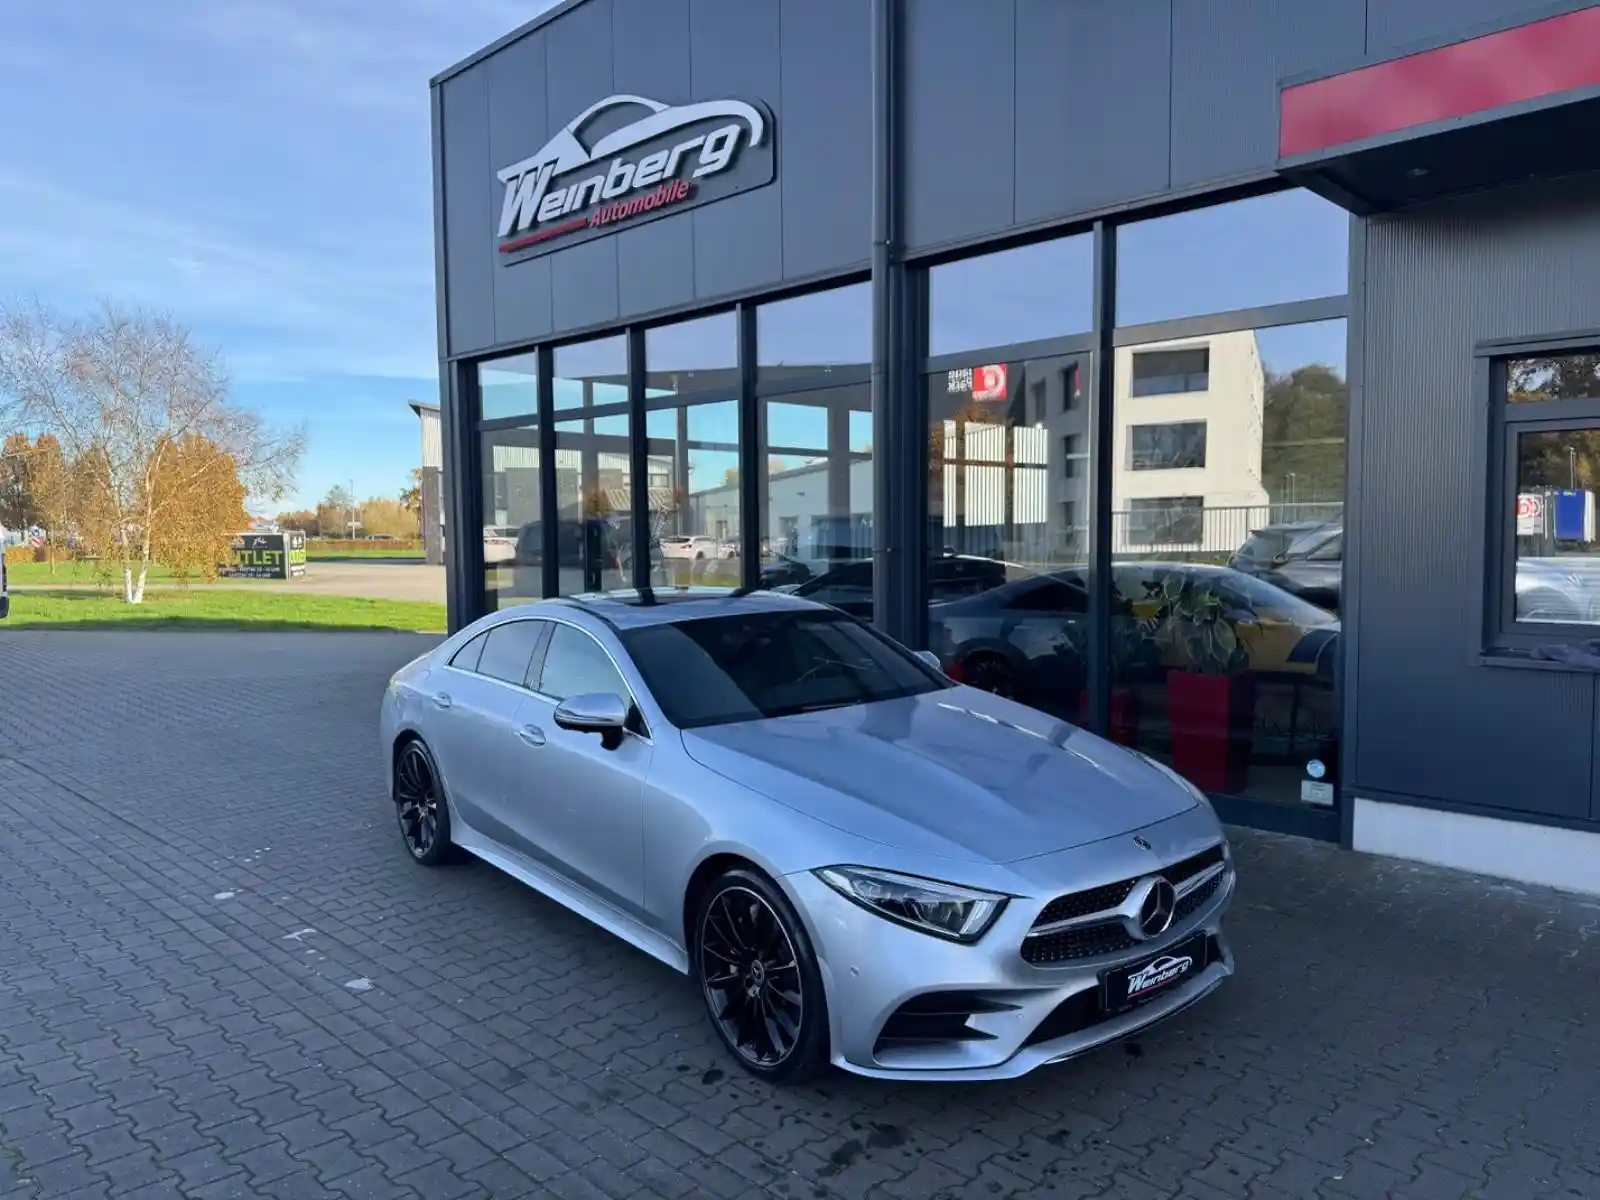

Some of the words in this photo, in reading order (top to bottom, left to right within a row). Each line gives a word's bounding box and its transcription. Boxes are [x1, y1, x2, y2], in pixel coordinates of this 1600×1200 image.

[497, 123, 742, 238] Weinberg
[588, 179, 691, 229] Automobile
[219, 550, 283, 565] UTLET
[1127, 961, 1189, 994] Weinberg
